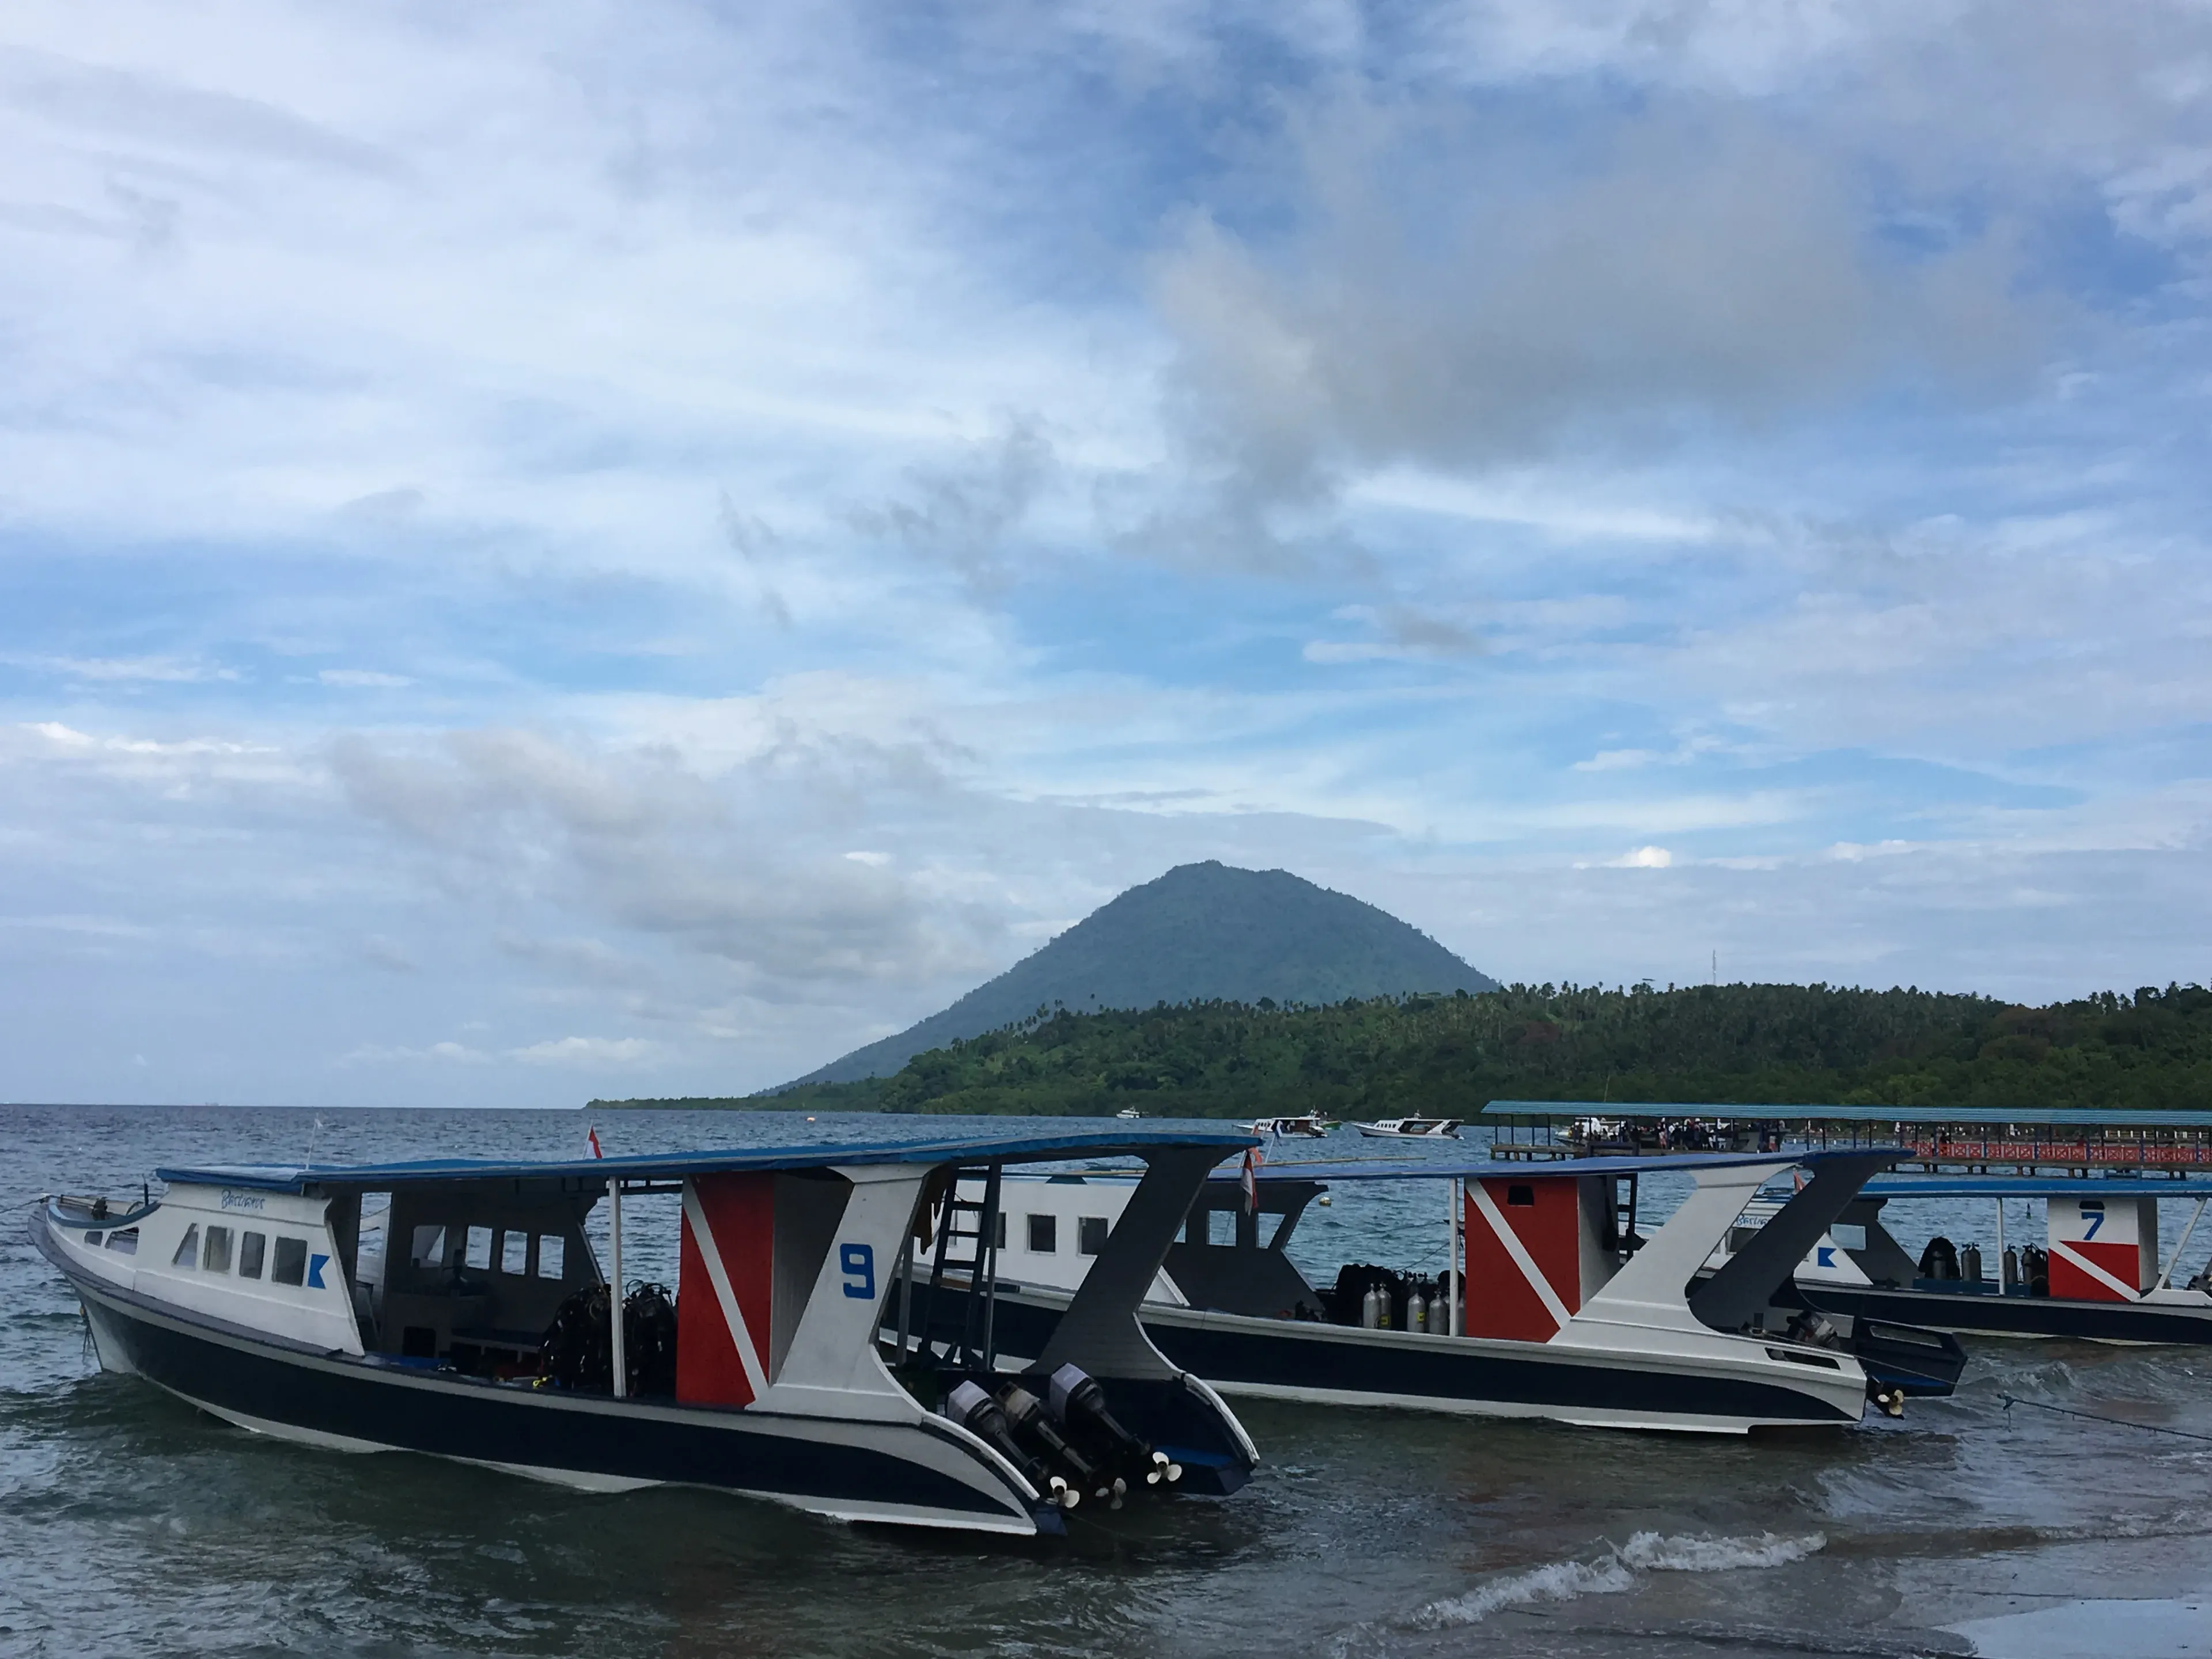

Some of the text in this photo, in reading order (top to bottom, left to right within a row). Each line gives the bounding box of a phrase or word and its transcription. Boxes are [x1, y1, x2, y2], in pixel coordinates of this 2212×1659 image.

[1736, 1214, 1768, 1226] Bastia
[2081, 1211, 2104, 1241] 7
[840, 1243, 876, 1300] 9
